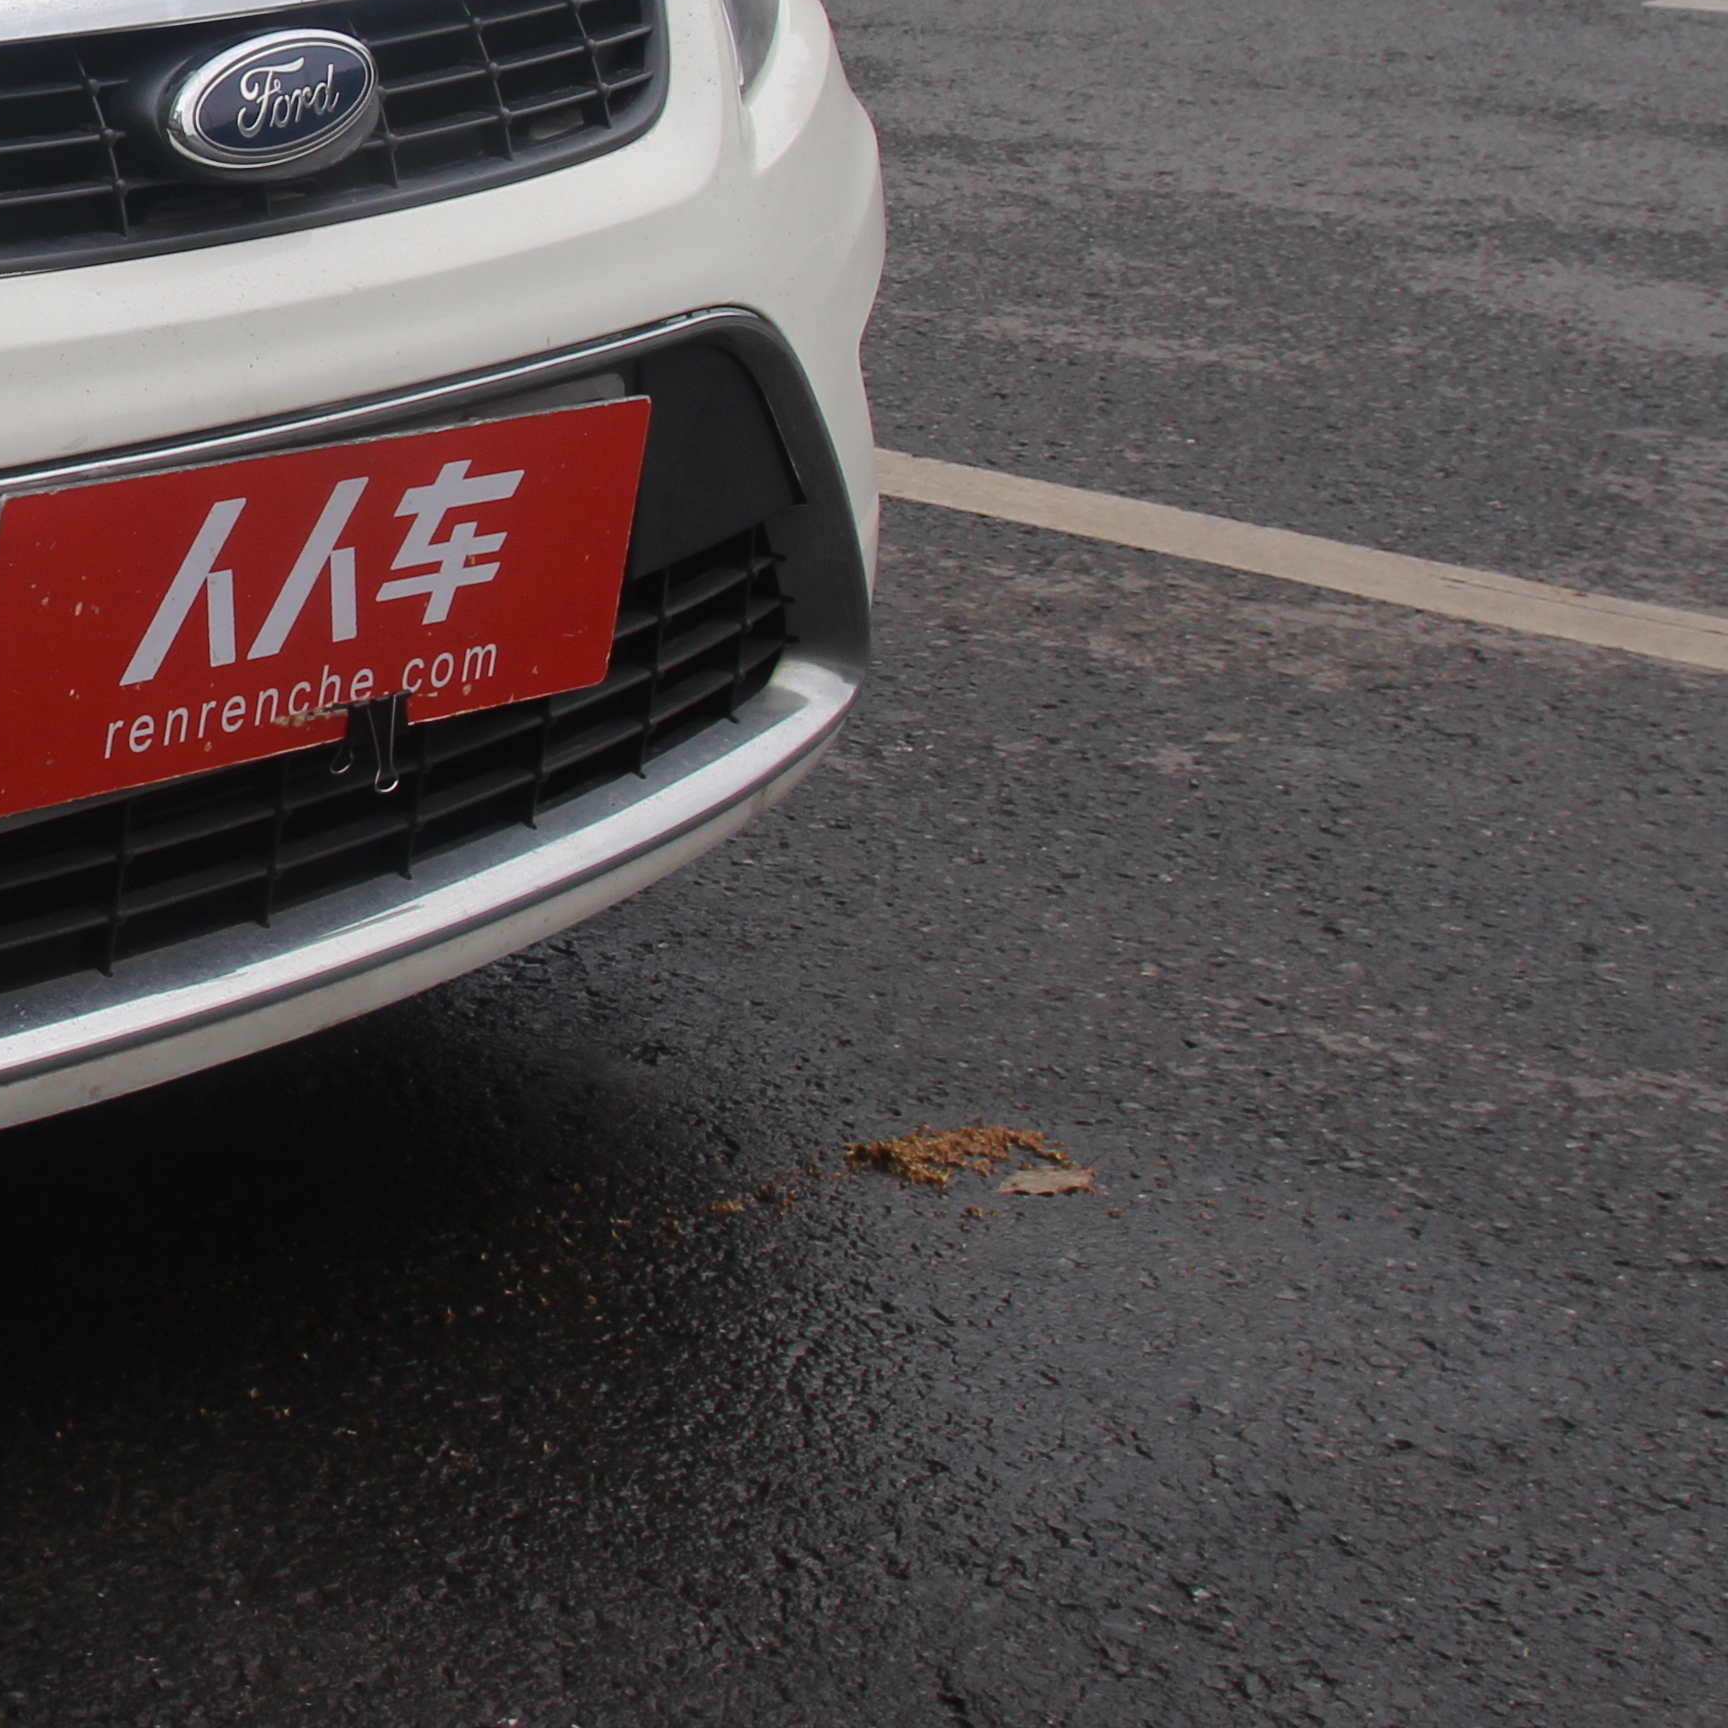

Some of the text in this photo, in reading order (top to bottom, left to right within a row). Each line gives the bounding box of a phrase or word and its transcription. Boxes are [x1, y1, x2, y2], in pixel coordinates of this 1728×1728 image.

[237, 57, 340, 138] Ford
[119, 459, 525, 686] 人人车
[104, 642, 498, 759] renrenche.com
